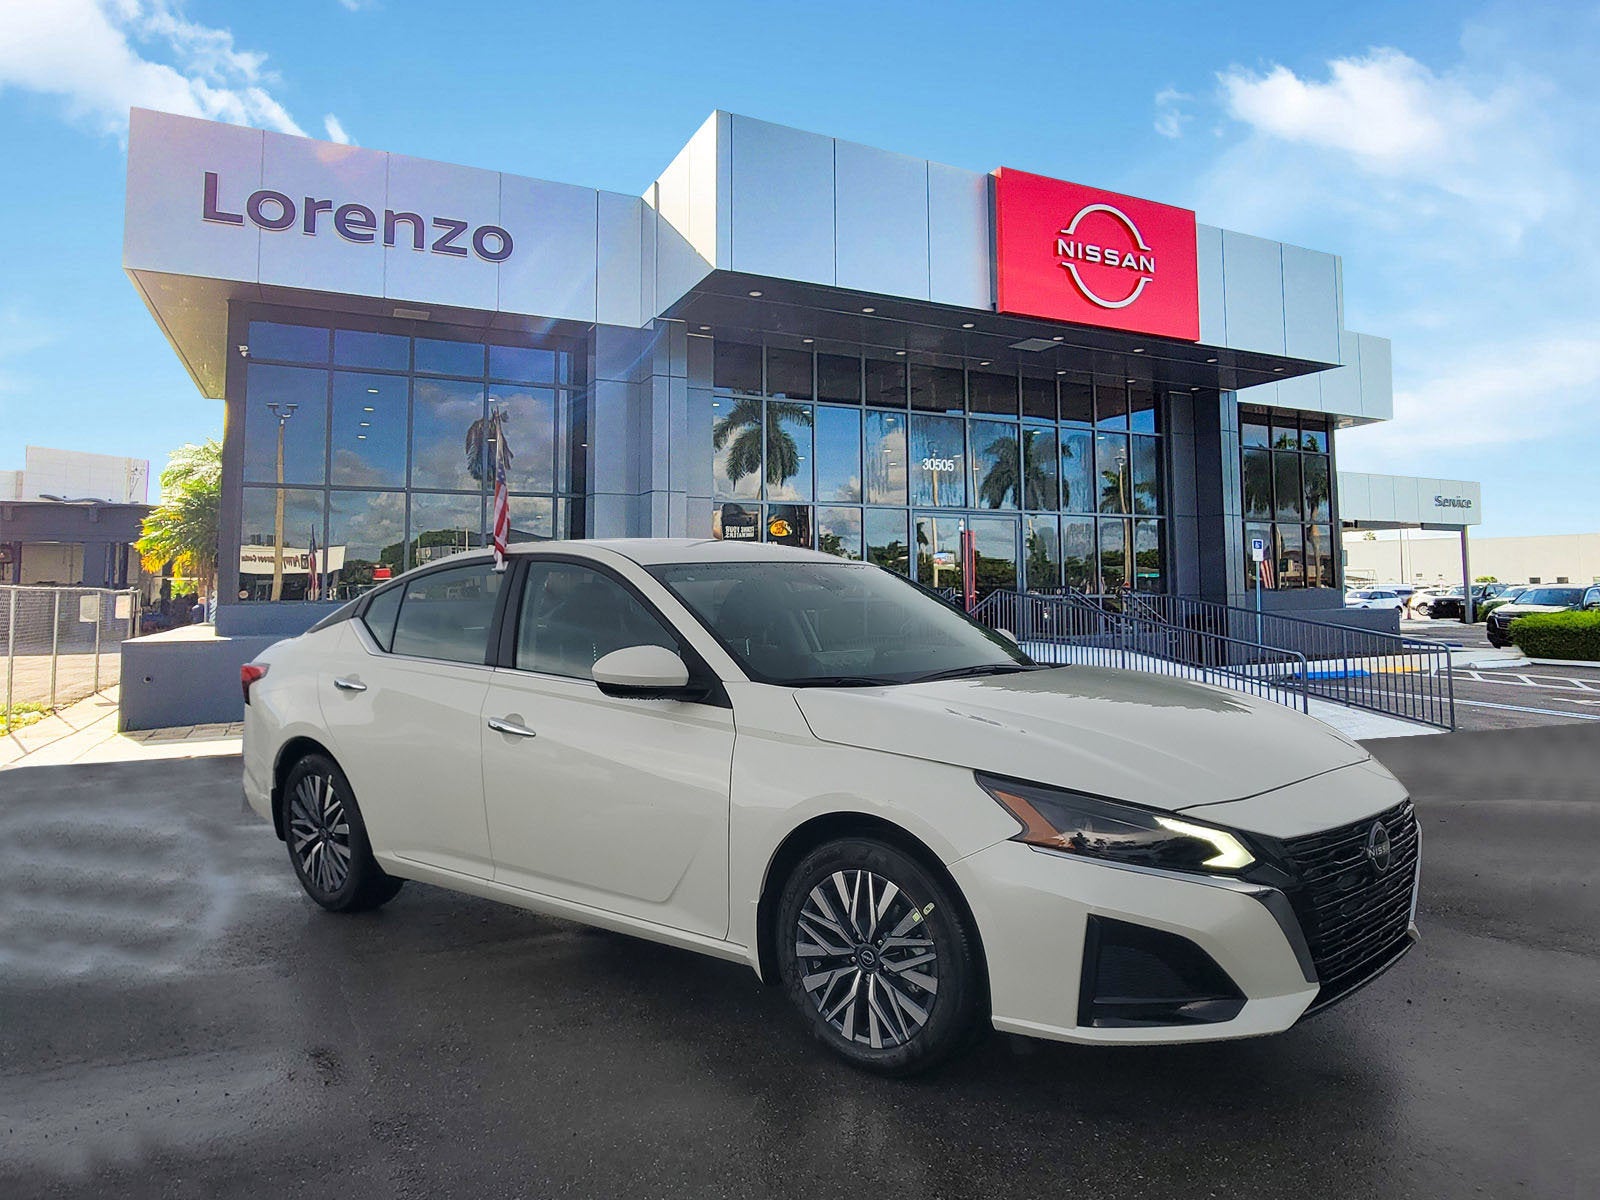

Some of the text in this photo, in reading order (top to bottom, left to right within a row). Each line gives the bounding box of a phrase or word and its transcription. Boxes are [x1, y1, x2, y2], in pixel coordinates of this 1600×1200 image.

[203, 171, 514, 262] Lorenzo
[1057, 239, 1155, 273] NISSAN
[922, 458, 954, 471] 30505
[1434, 495, 1472, 508] Service
